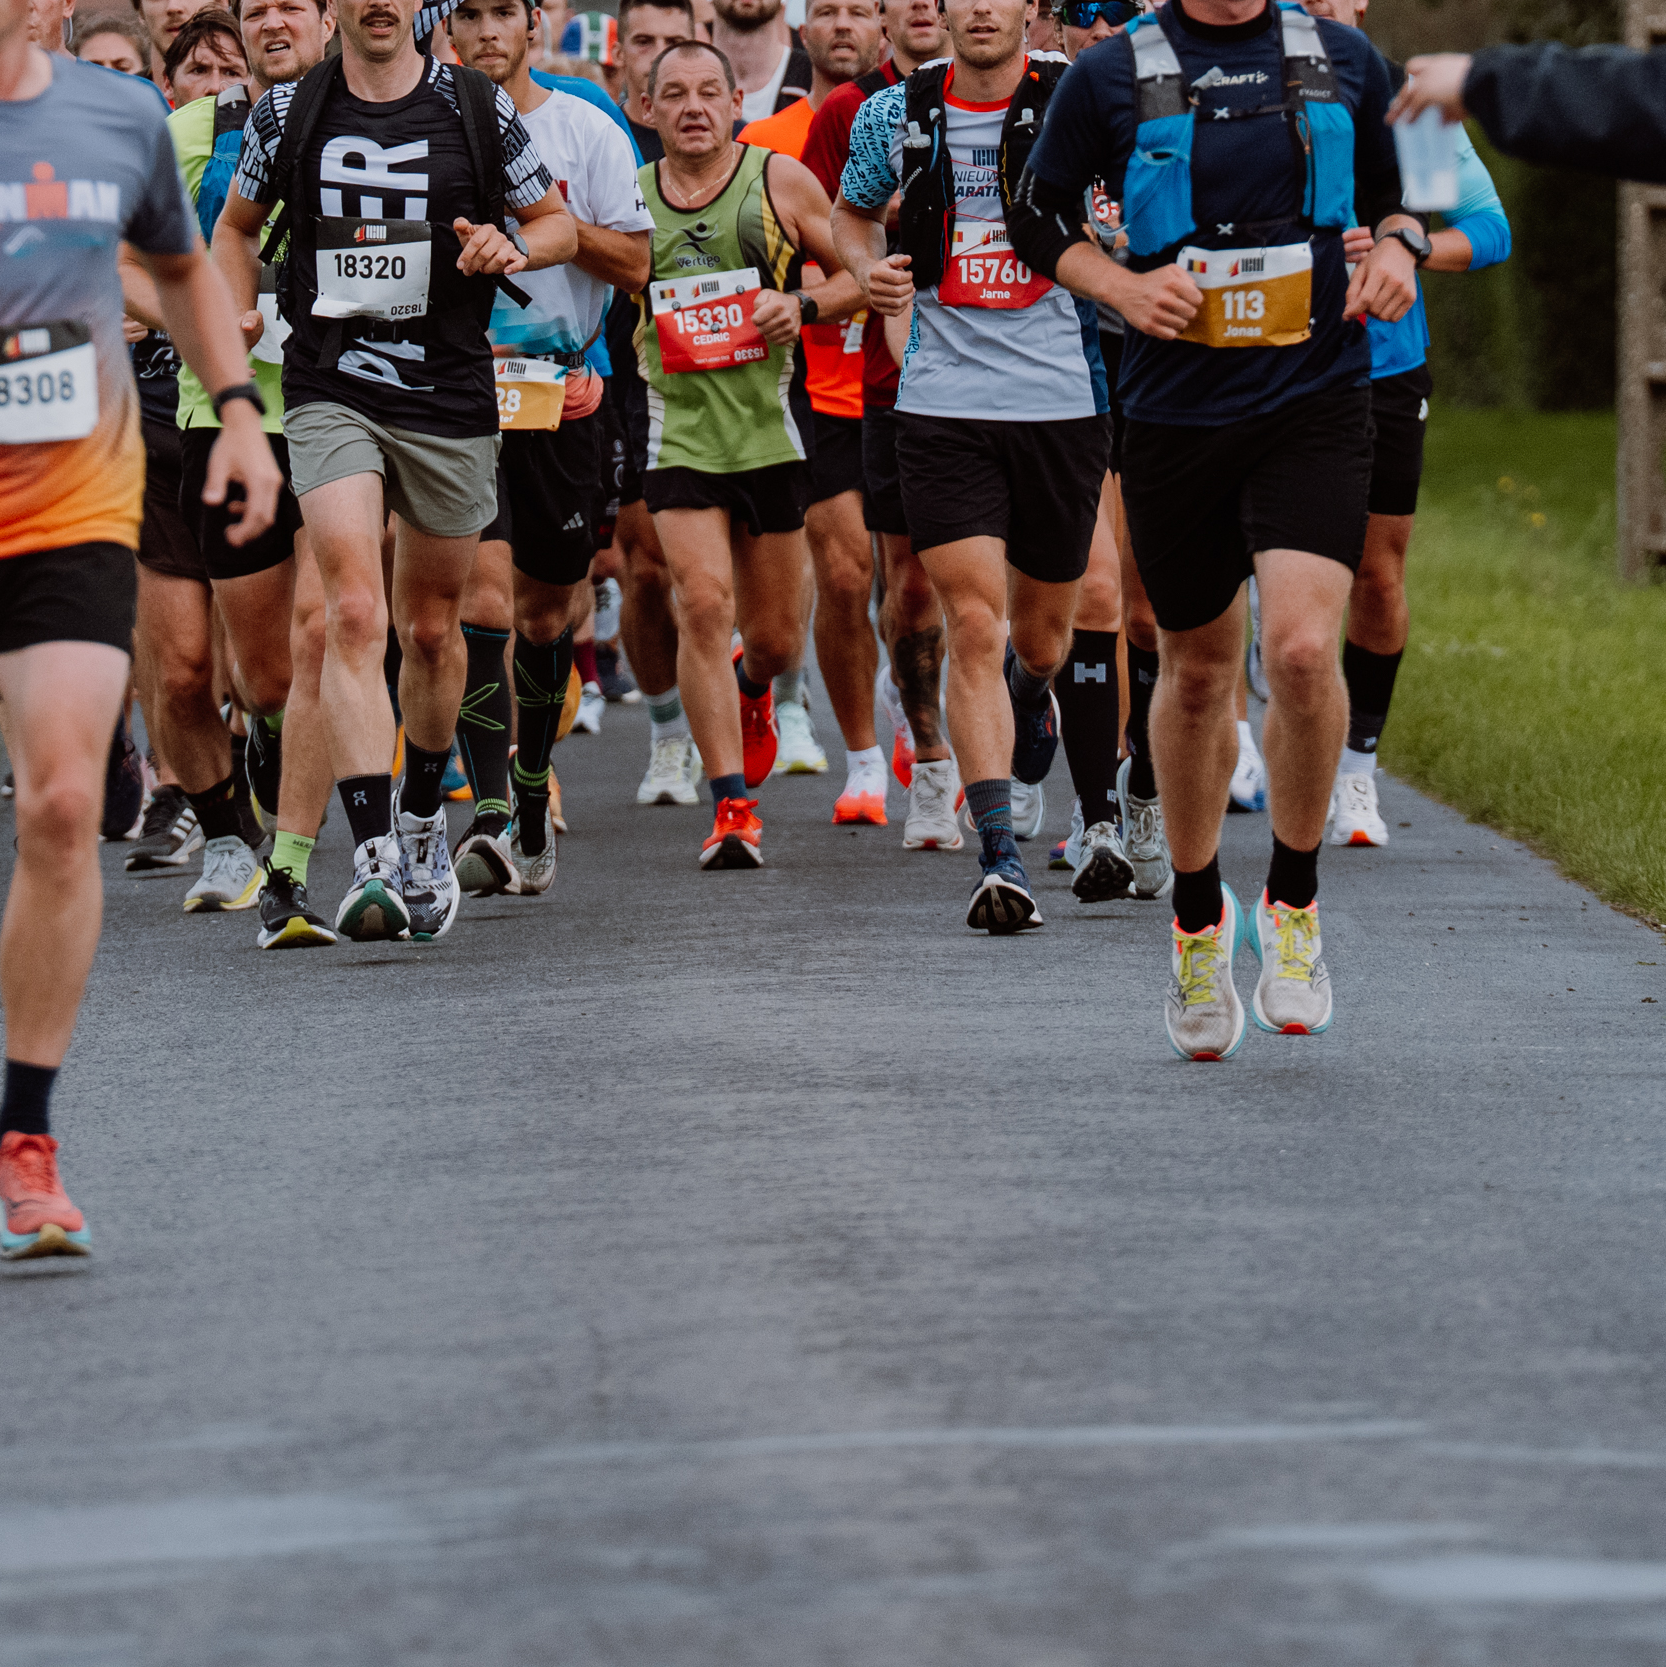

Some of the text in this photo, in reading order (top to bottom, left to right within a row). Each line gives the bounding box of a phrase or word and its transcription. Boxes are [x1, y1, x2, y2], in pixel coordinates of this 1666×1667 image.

[954, 185, 1001, 197] ARATH
[334, 253, 406, 279] 18320
[675, 255, 721, 269] Vertigo
[958, 258, 1032, 284] 15760
[979, 288, 1011, 299] Jarne
[390, 303, 422, 315] 18320
[1222, 290, 1265, 320] 113
[673, 303, 744, 334] 15330
[1223, 324, 1263, 337] Jonas
[692, 332, 730, 345] CEDRIC
[734, 347, 764, 361] 15330
